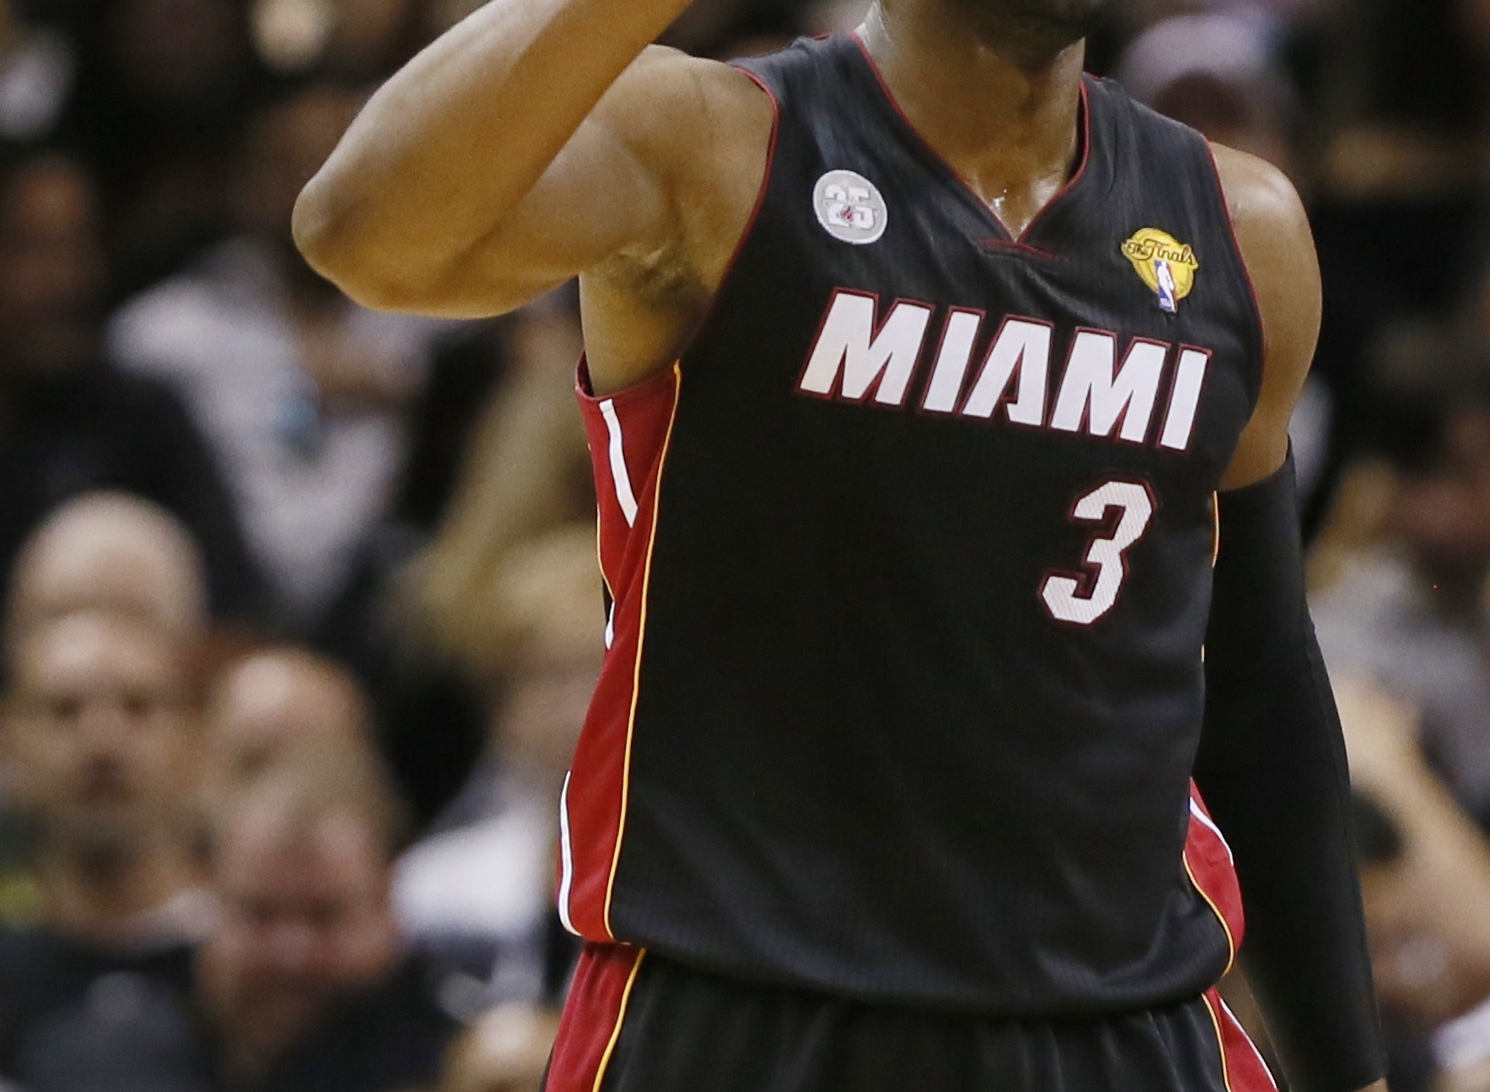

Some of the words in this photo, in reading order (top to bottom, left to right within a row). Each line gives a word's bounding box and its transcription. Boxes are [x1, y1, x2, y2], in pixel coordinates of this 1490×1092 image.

[1138, 238, 1195, 266] Finals
[798, 288, 1211, 453] MIAMI
[1039, 476, 1157, 626] 3
